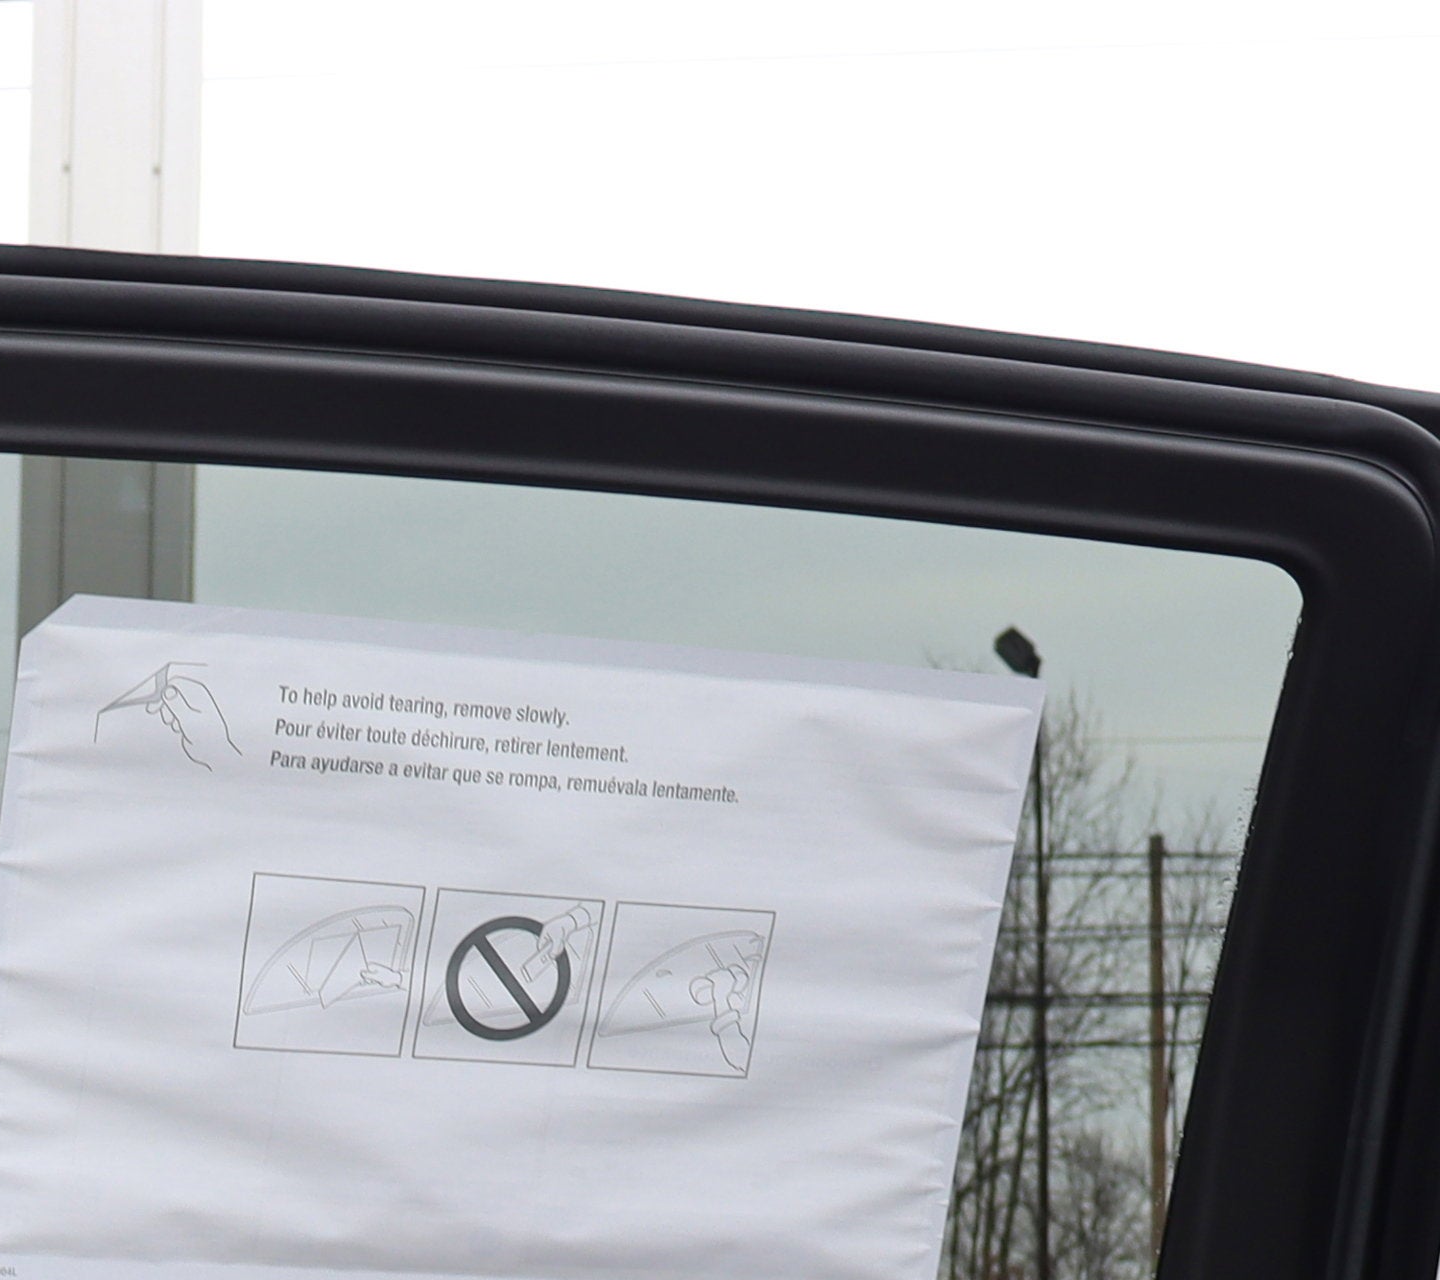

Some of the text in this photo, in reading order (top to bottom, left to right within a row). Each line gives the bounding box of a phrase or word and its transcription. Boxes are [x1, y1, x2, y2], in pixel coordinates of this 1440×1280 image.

[279, 685, 570, 729] To help avoid tearing, remove slowly.
[275, 718, 629, 763] Pour éviter toute déchirure, retirer lentement.
[270, 750, 739, 803] Para ayudarse a evitar que se rompa, remuévala lentamente.
